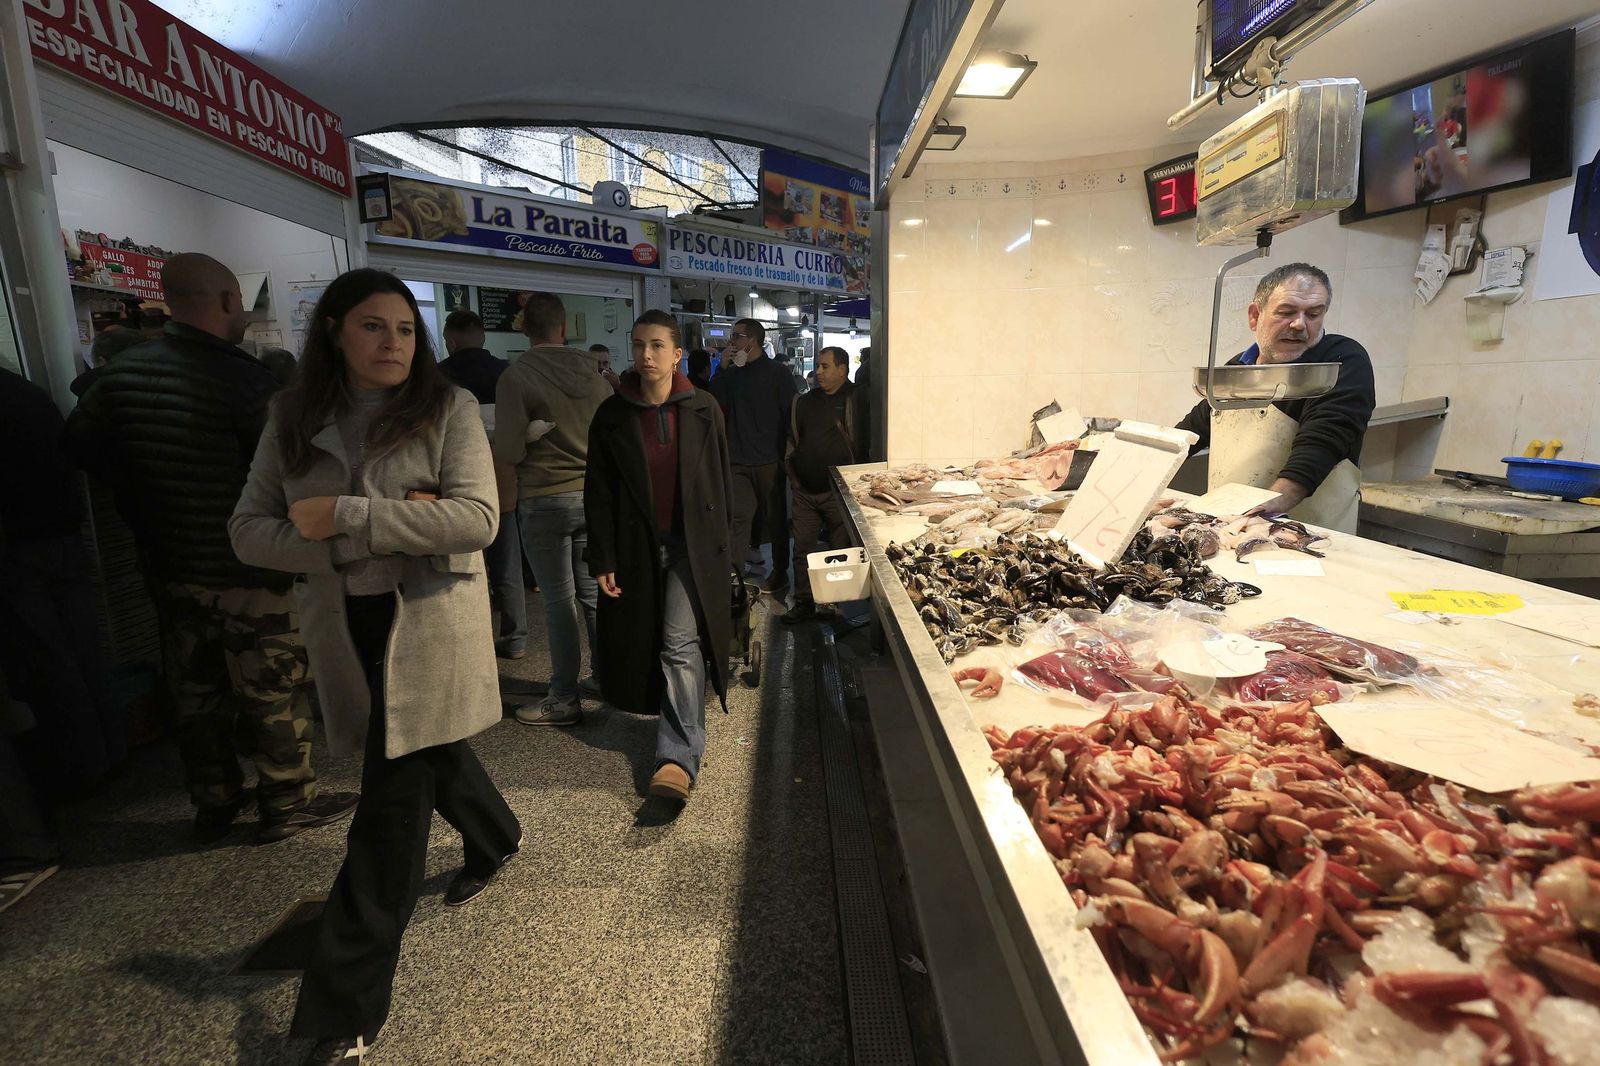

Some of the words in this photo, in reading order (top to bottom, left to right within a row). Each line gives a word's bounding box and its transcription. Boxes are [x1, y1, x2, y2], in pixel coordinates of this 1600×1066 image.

[26, 16, 200, 120] ESPECIALIDAD
[206, 106, 232, 136] EN
[237, 120, 308, 171] PESCAITO
[311, 157, 346, 188] FRITO
[163, 23, 327, 155] ANTONIO
[333, 118, 343, 134] 24
[1152, 163, 1188, 180] SERVIAMO
[471, 196, 514, 228] La
[524, 204, 630, 245] Paraita
[102, 250, 126, 262] GALLO
[111, 240, 151, 255] TAPAS
[504, 233, 568, 256] Pescaito
[568, 243, 604, 261] Frito
[669, 228, 785, 267] PESCADERIA
[794, 250, 843, 275] CURRO
[688, 255, 725, 273] Pescado
[726, 261, 753, 277] fresco
[754, 265, 764, 278] de
[765, 267, 801, 283] trasmallo
[807, 272, 816, 285] de
[817, 273, 824, 286] la
[130, 288, 165, 300] NTILLITAS
